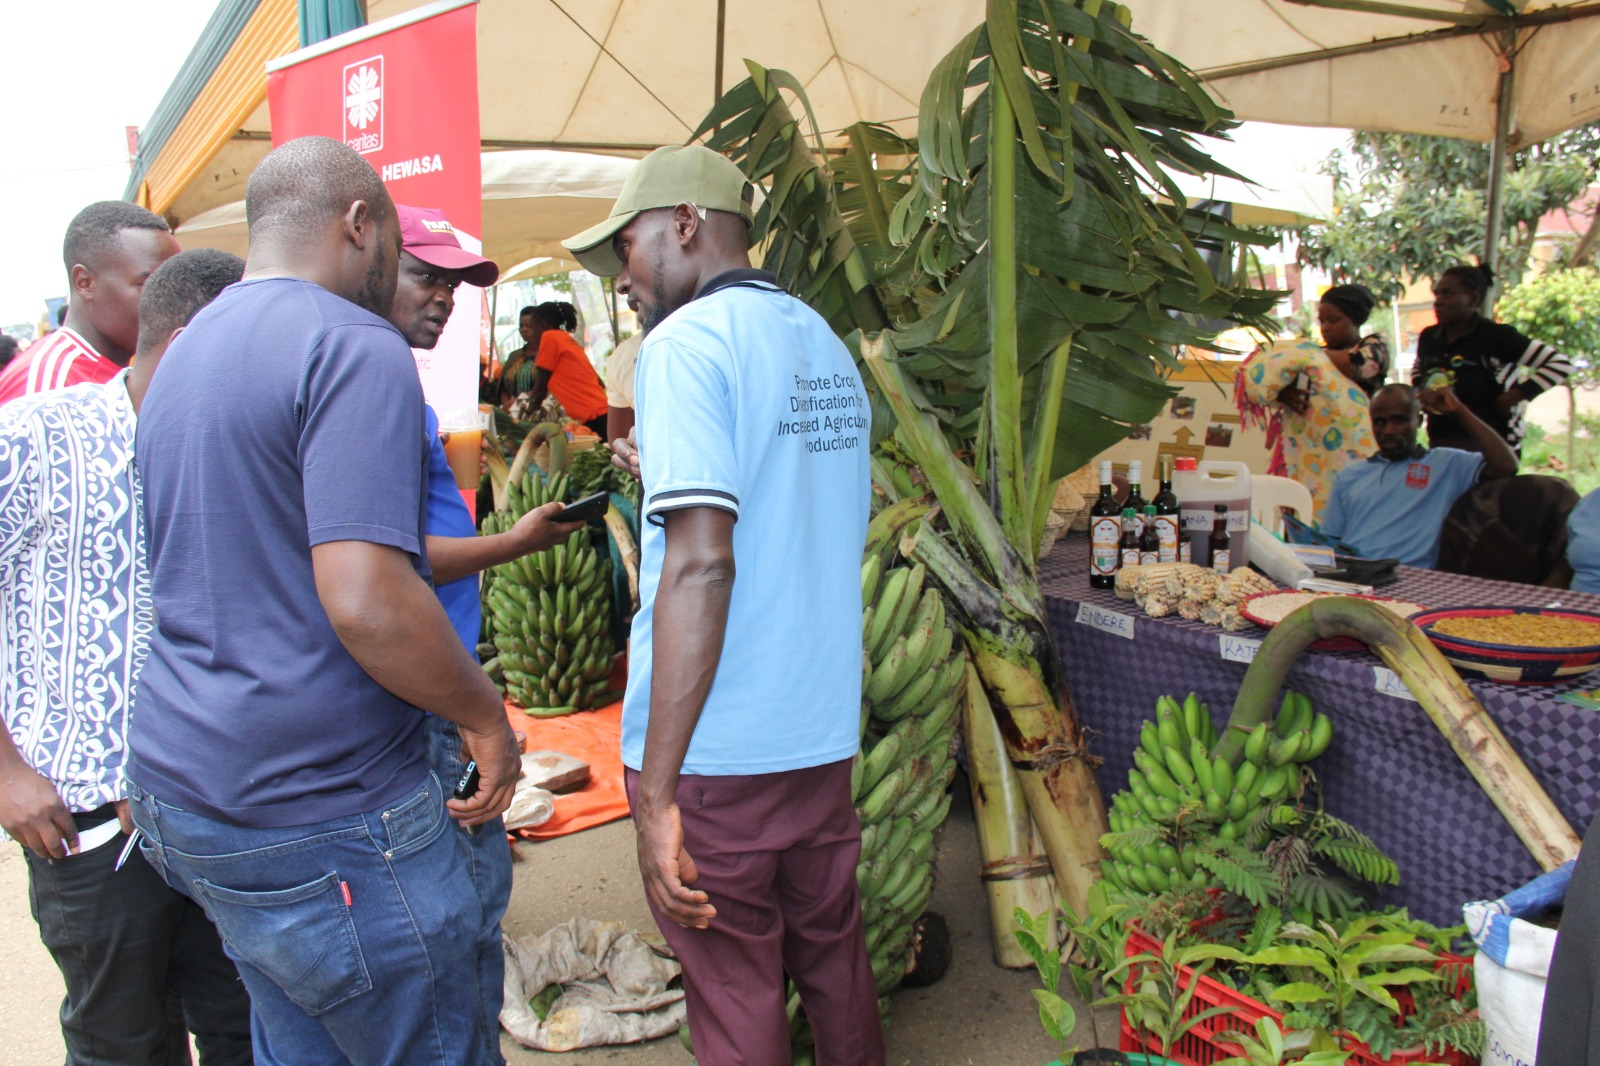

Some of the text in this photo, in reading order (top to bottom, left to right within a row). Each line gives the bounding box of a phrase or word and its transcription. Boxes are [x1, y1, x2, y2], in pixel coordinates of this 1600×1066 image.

[346, 132, 379, 152] caritas
[382, 154, 443, 182] HEWASA
[1081, 606, 1127, 632] ENDERE
